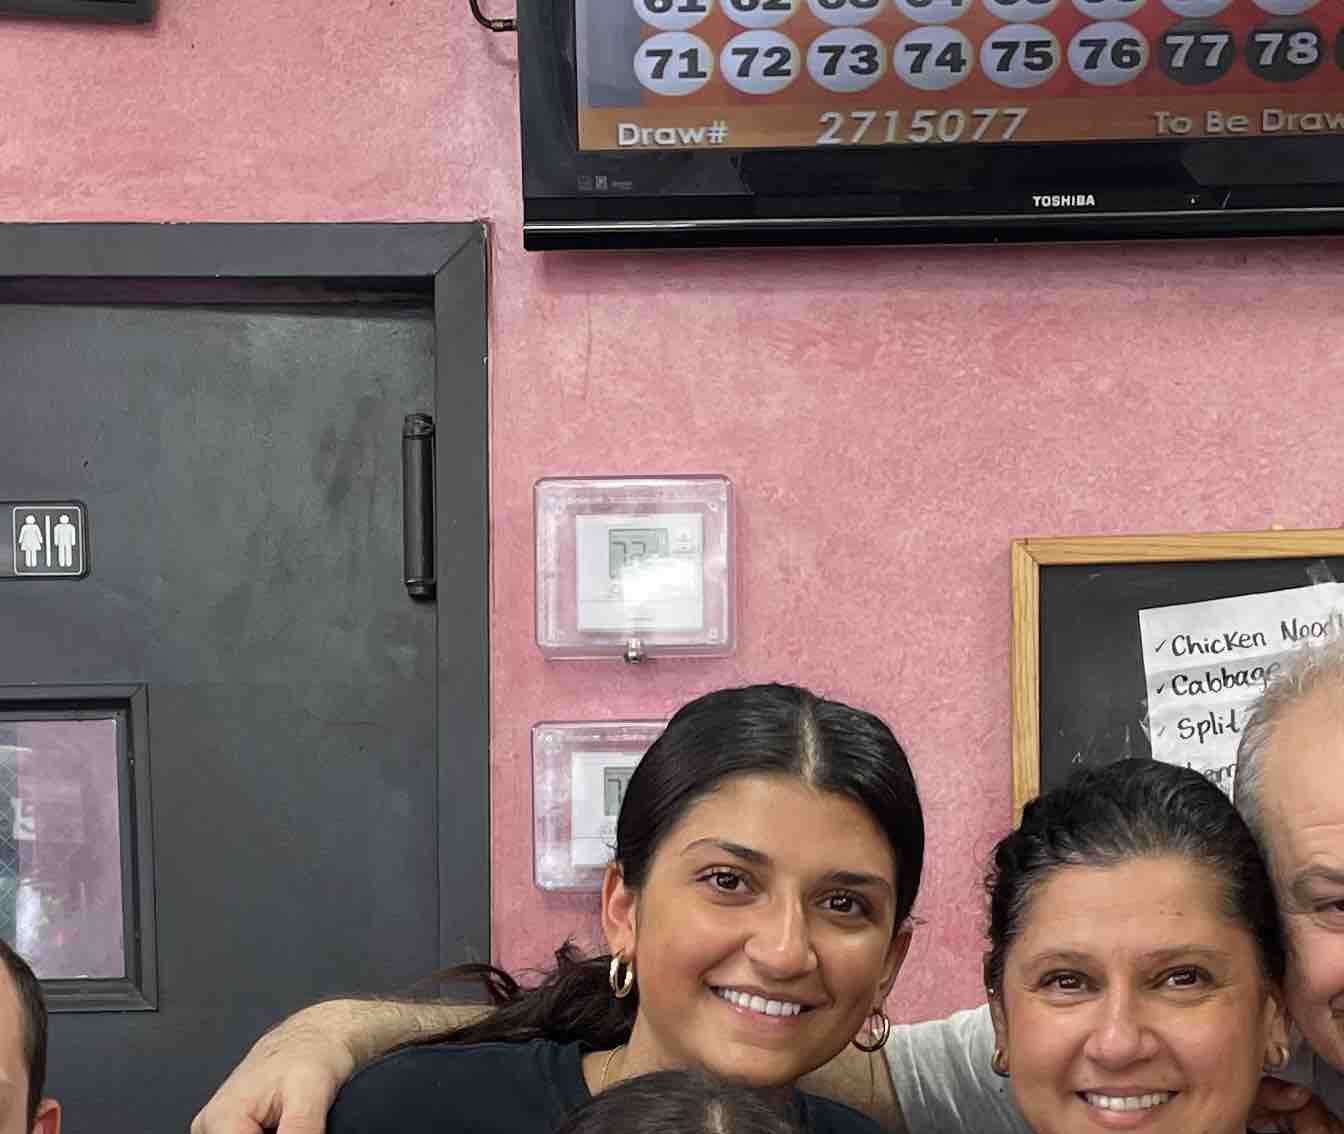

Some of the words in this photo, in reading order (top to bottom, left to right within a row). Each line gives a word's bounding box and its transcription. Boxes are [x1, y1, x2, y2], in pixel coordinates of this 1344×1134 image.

[645, 48, 707, 79] 71
[731, 46, 792, 78] 72
[817, 44, 879, 76] 73
[904, 42, 967, 74] 74
[991, 40, 1054, 72] 75
[1078, 37, 1142, 70] 76
[1165, 34, 1230, 68] 77
[1254, 32, 1320, 66] 78
[617, 120, 729, 146] Draw#
[816, 108, 1029, 145] 2715077
[1155, 111, 1193, 135] To
[1206, 110, 1249, 133] Be
[1032, 194, 1096, 207] TOSHIBA
[1177, 709, 1241, 744] Split
